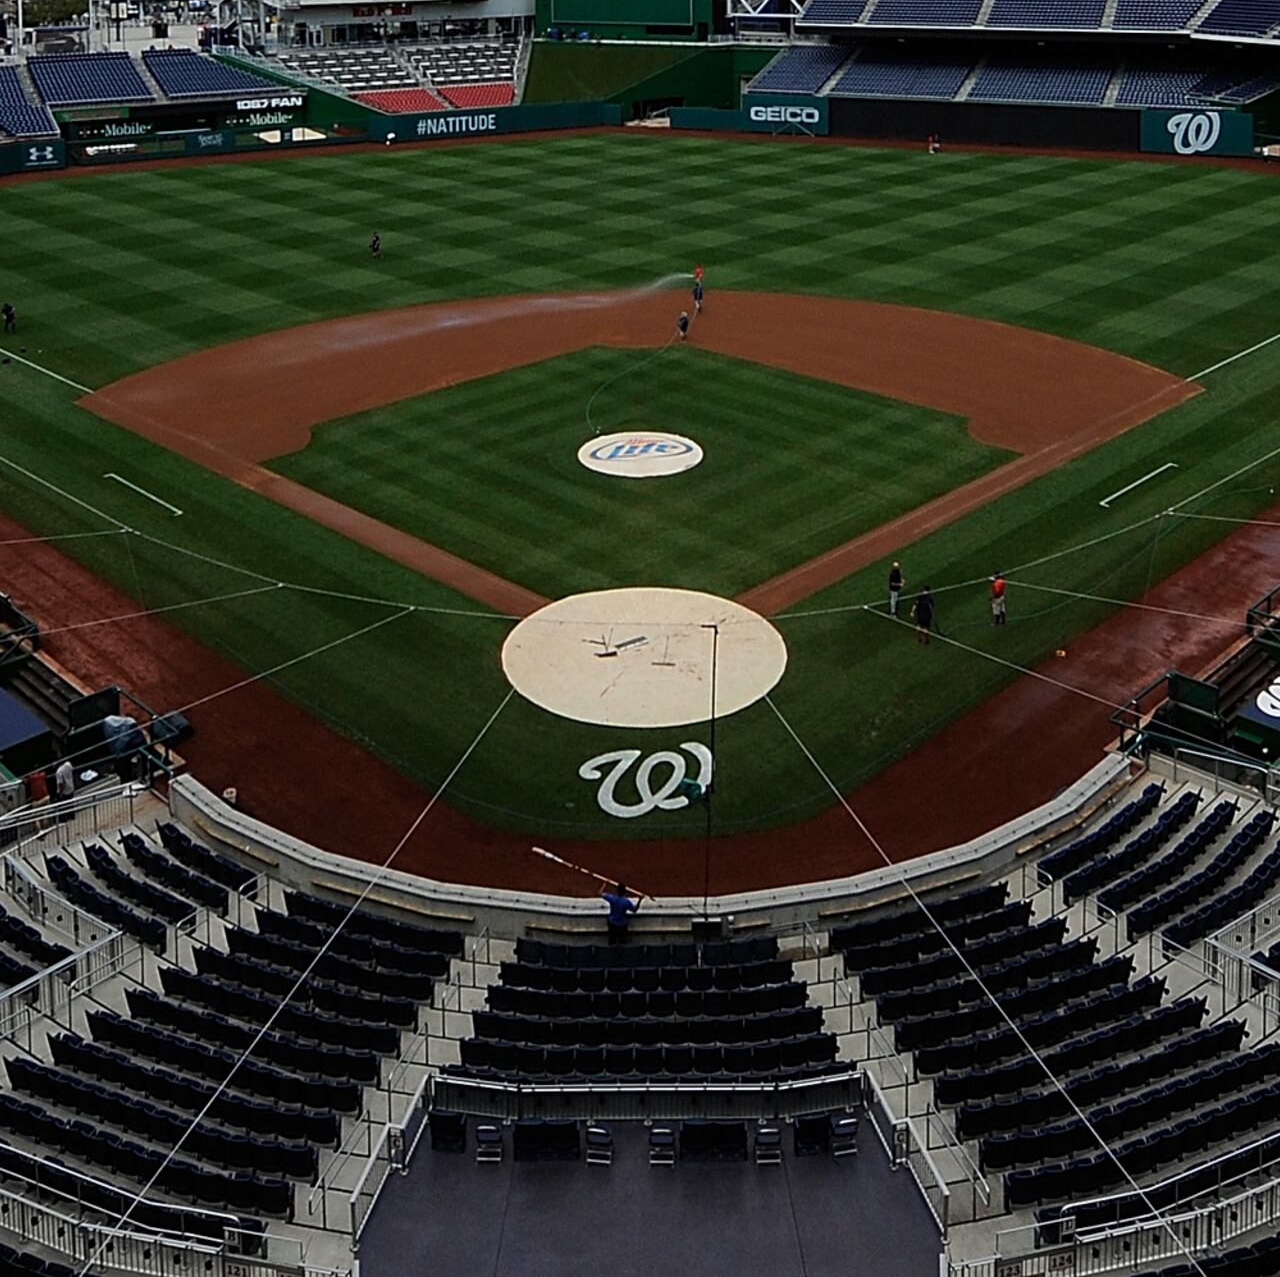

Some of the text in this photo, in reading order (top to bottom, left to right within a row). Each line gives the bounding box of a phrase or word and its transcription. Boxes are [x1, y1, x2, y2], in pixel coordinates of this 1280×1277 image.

[271, 96, 303, 108] FAN
[750, 106, 819, 123] GEICO
[416, 113, 497, 135] #NATITUDE
[607, 442, 679, 459] Lite
[1052, 1254, 1072, 1268] 124
[227, 1265, 247, 1277] 121
[1000, 1265, 1021, 1277] 123
